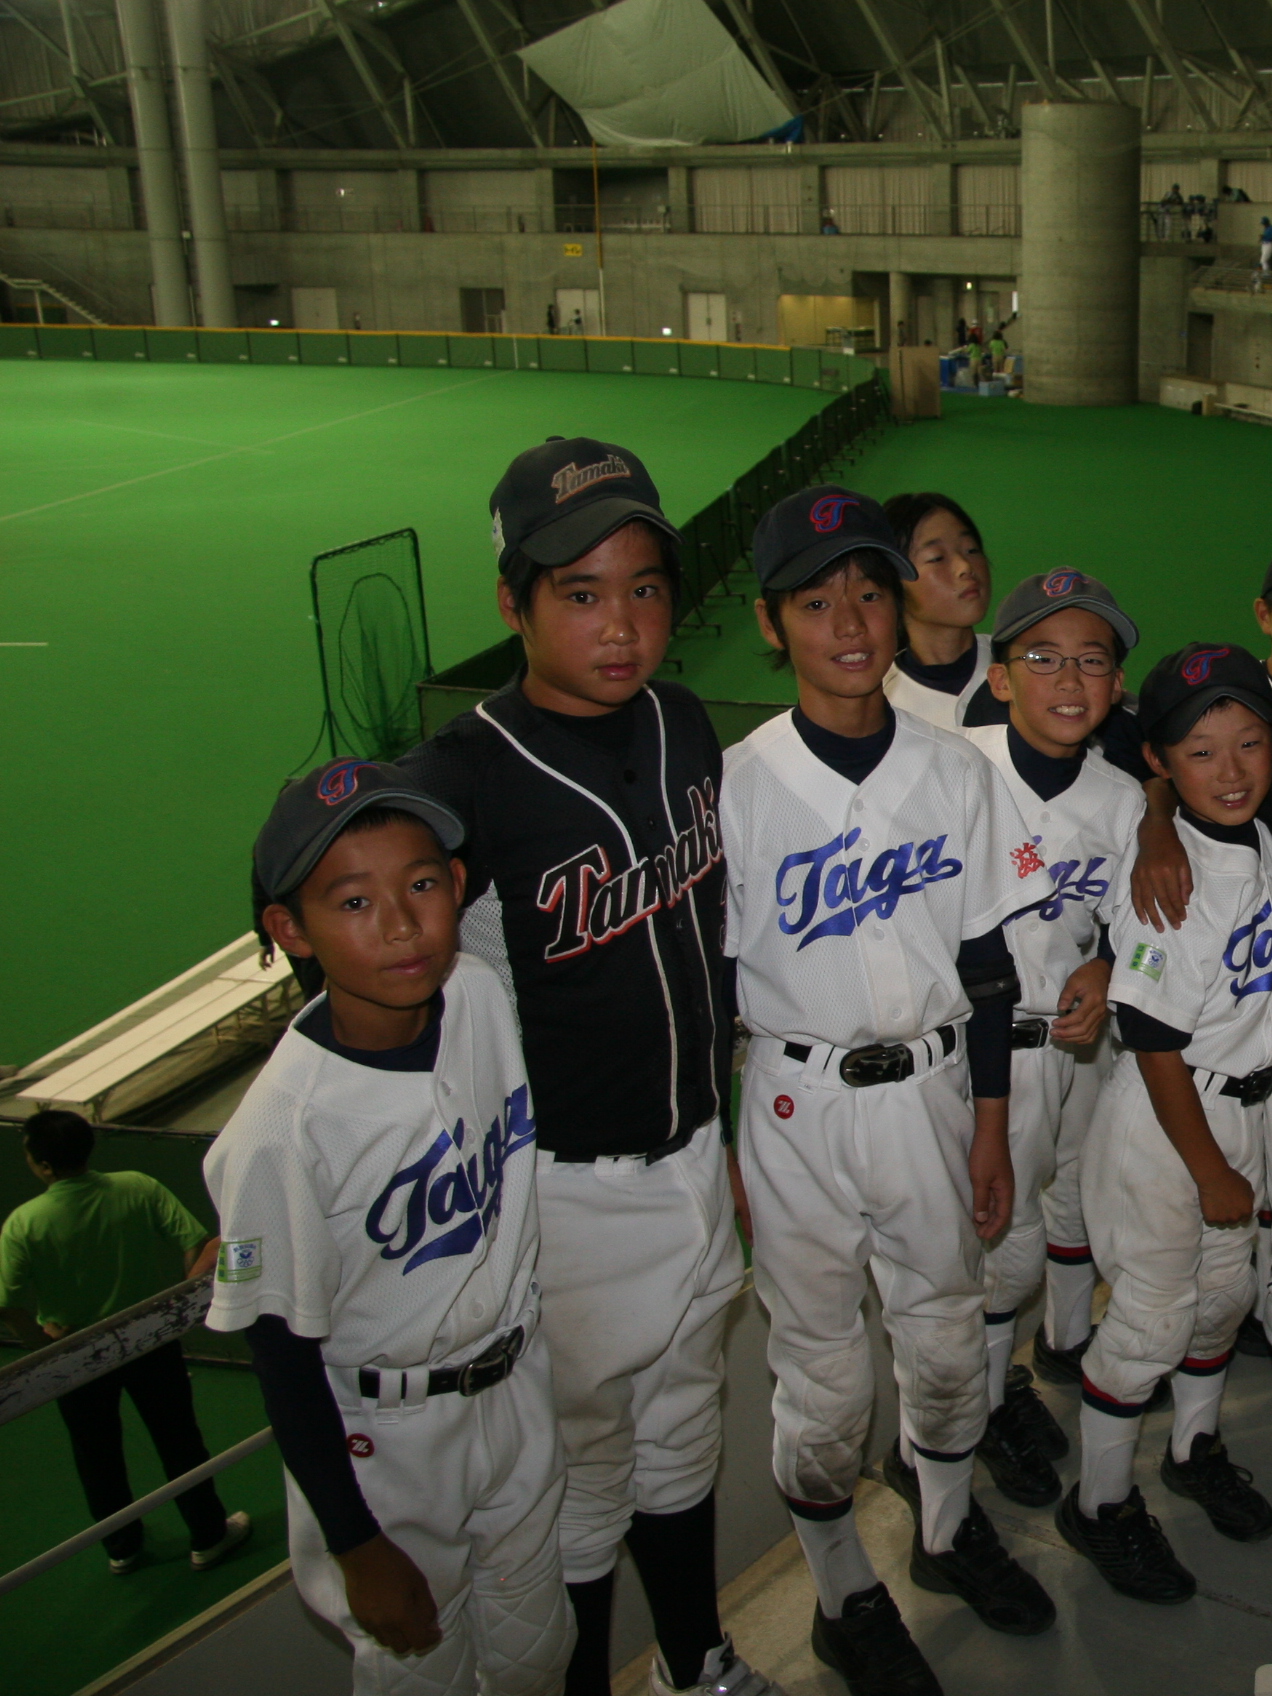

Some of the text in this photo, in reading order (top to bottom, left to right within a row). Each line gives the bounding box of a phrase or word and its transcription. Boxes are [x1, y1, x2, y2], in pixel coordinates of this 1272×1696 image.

[551, 454, 631, 504] Tamaki
[537, 776, 724, 964] Tamaki
[776, 826, 963, 952] Taga
[366, 1082, 538, 1277] Taga
